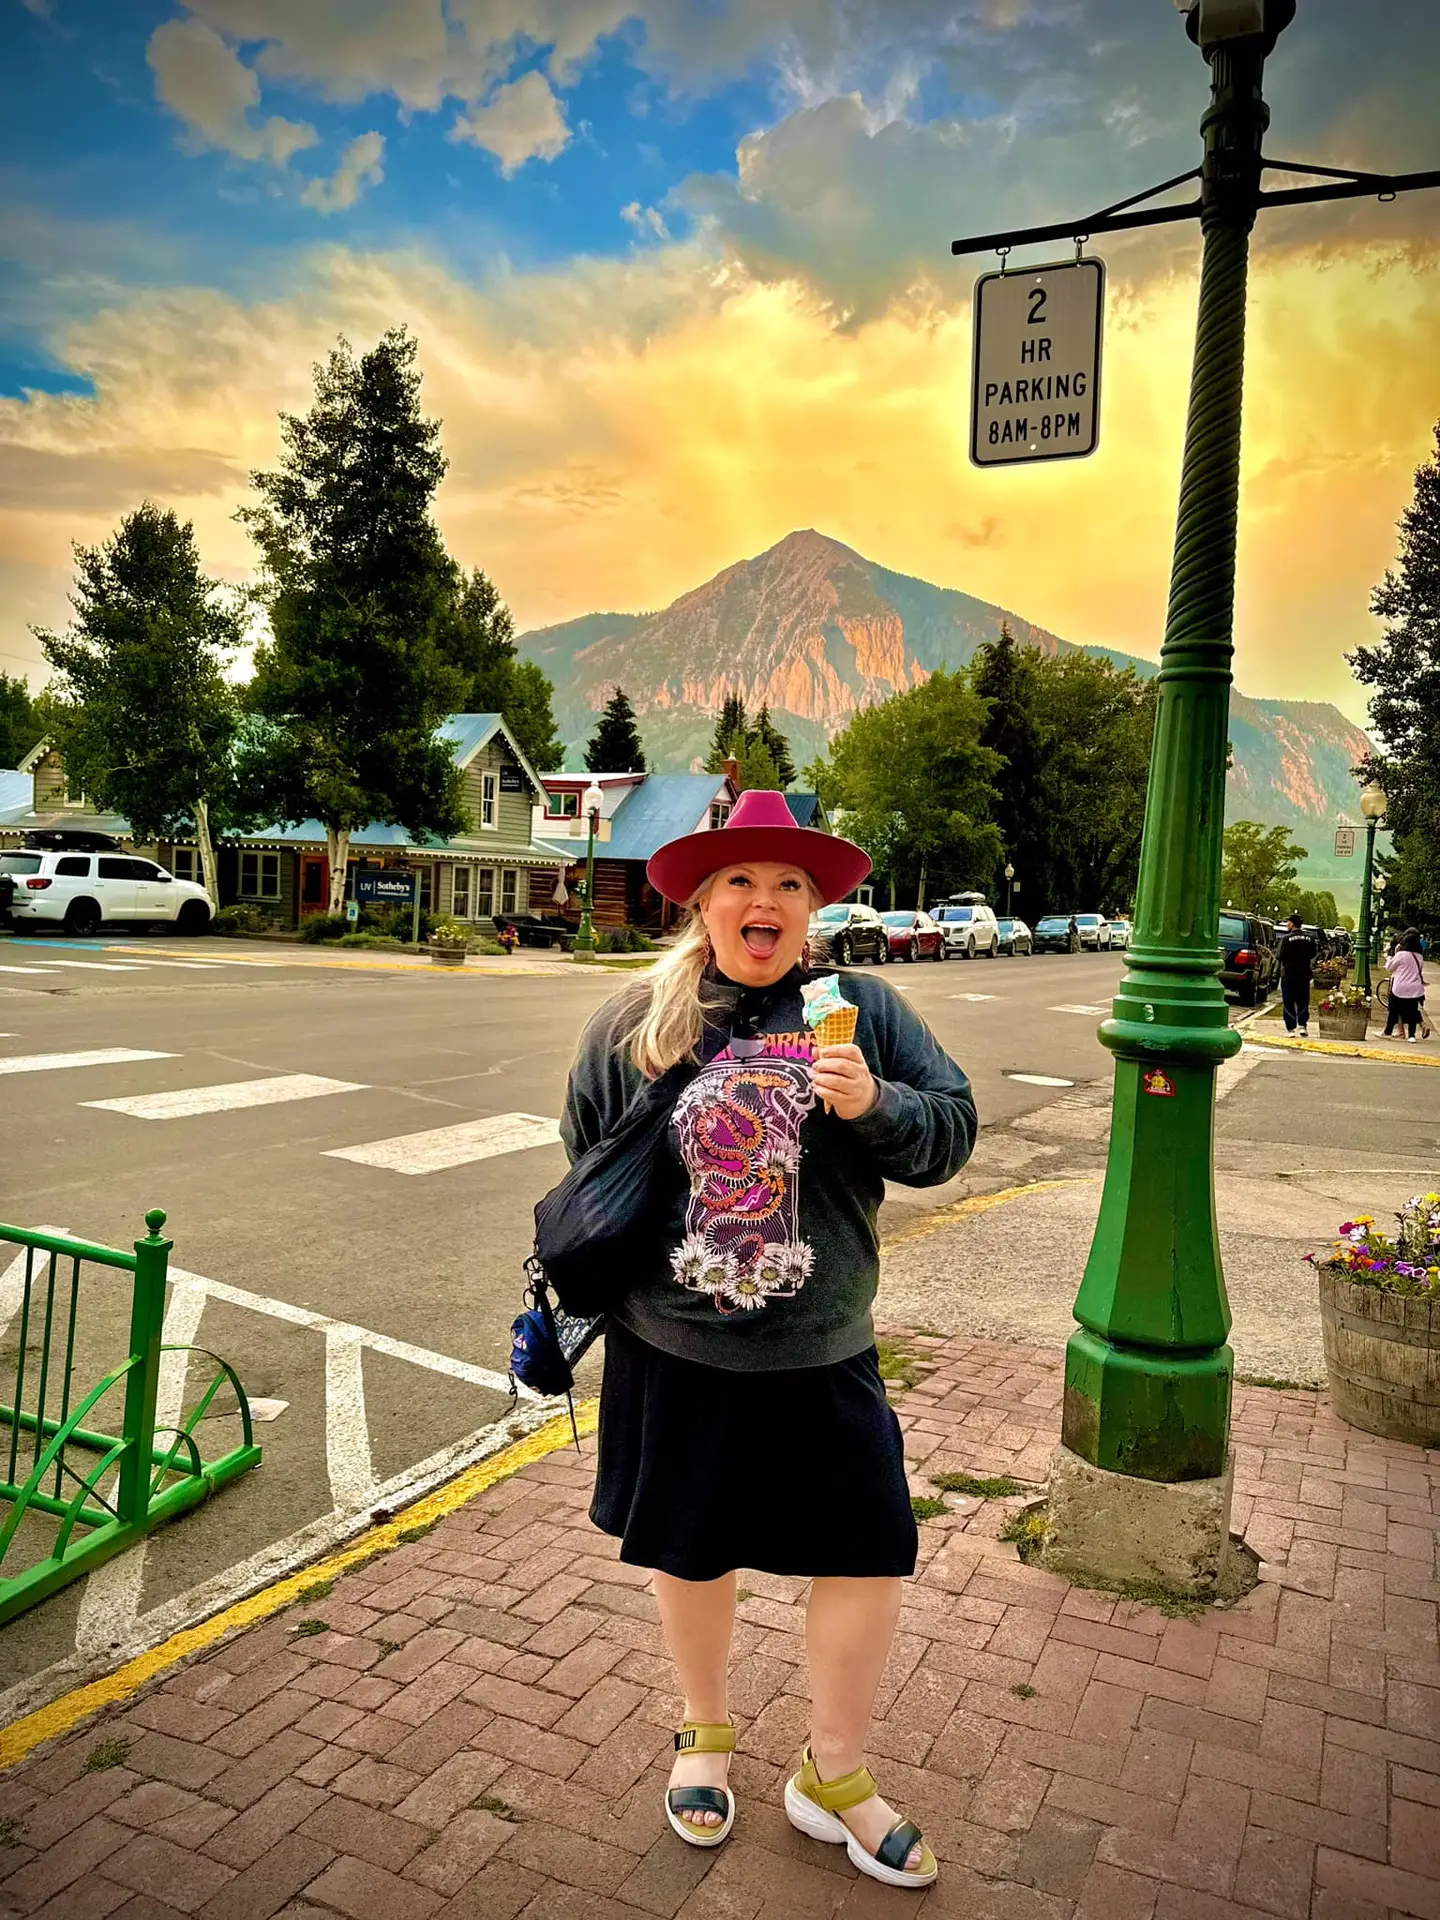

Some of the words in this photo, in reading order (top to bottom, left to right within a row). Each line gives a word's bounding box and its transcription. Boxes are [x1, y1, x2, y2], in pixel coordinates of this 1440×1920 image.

[1027, 288, 1047, 325] 2
[1021, 338, 1052, 364] HR
[985, 372, 1087, 407] PARKING
[988, 412, 1081, 445] 8AM-8PM
[377, 881, 410, 892] Sotheby's
